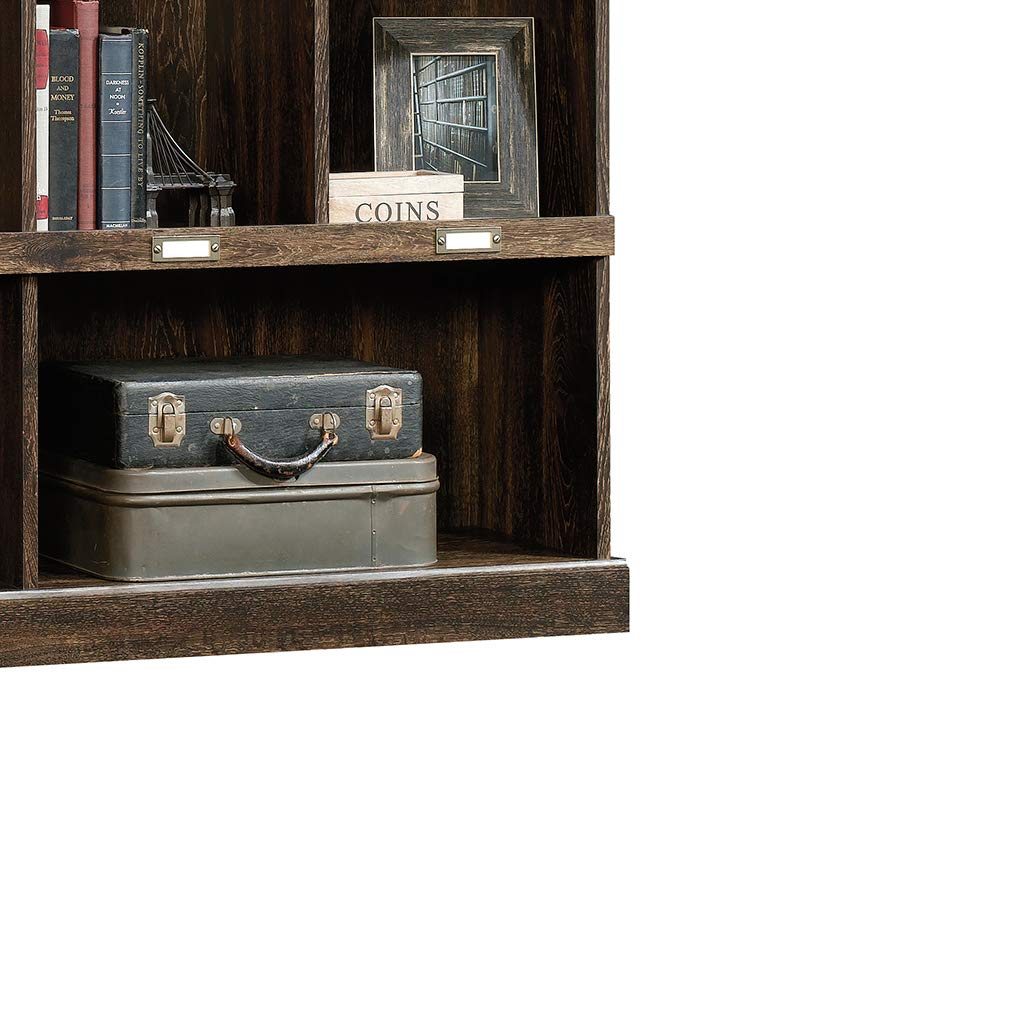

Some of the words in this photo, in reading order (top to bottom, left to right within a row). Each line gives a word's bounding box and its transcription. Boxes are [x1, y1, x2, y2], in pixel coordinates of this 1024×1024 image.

[137, 138, 144, 149] TO
[137, 176, 144, 188] BY
[355, 200, 440, 223] COINS
